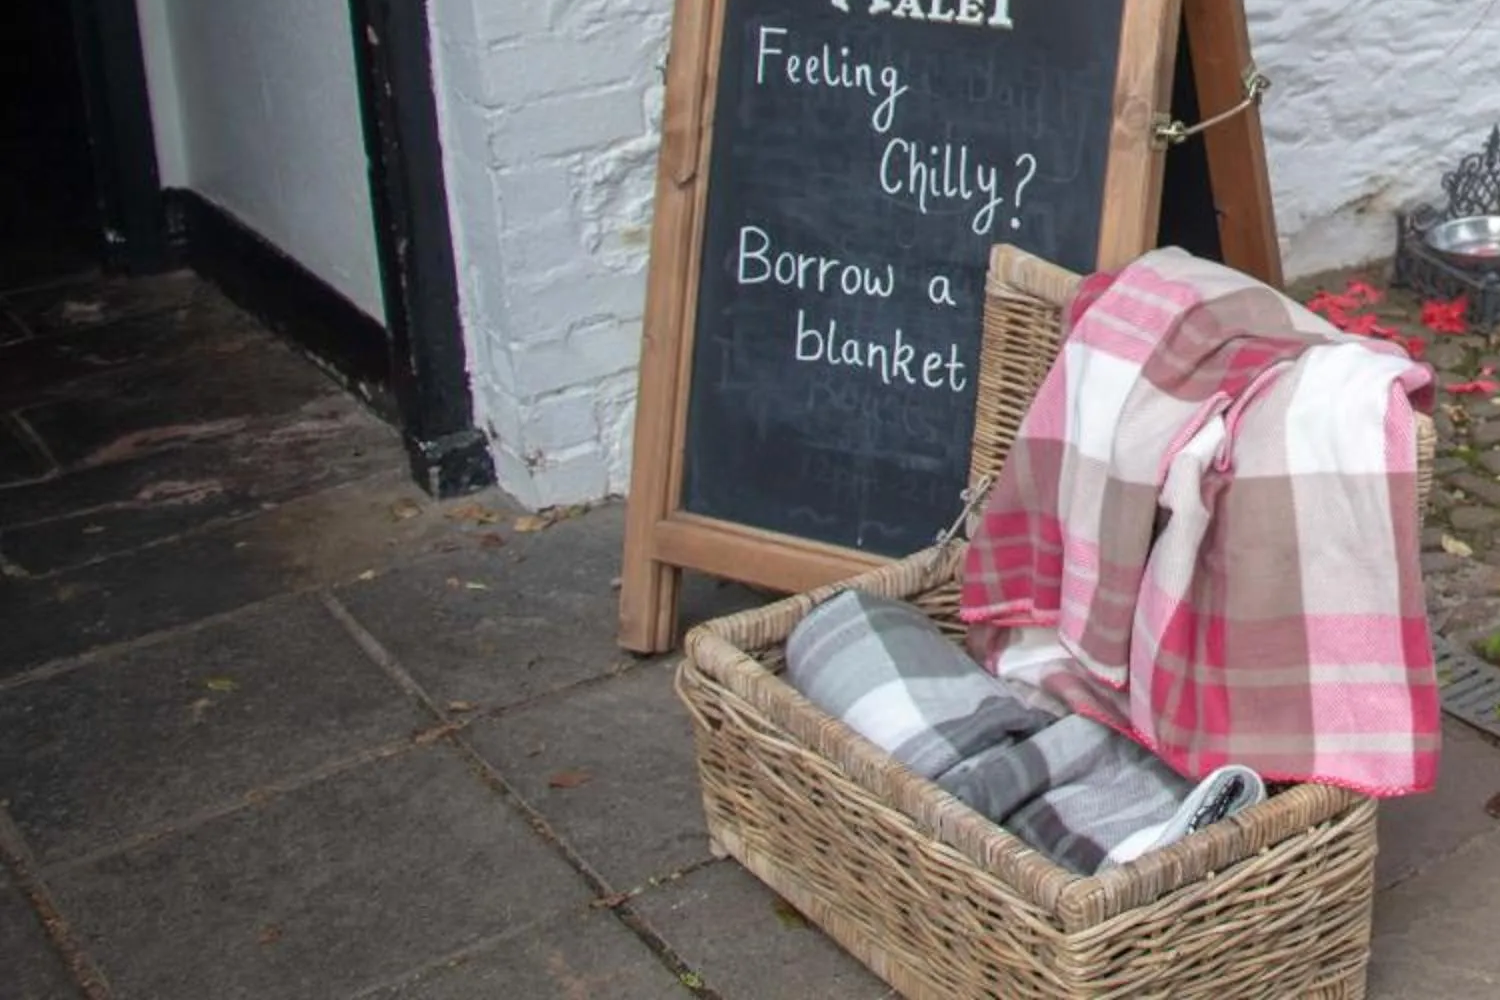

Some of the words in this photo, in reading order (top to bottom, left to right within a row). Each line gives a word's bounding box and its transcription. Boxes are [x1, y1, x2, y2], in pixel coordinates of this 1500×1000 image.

[756, 25, 909, 133] Feeling
[879, 137, 1037, 235] Chilly?
[737, 225, 895, 298] Borrow
[928, 275, 957, 306] a
[795, 309, 967, 393] blanket
